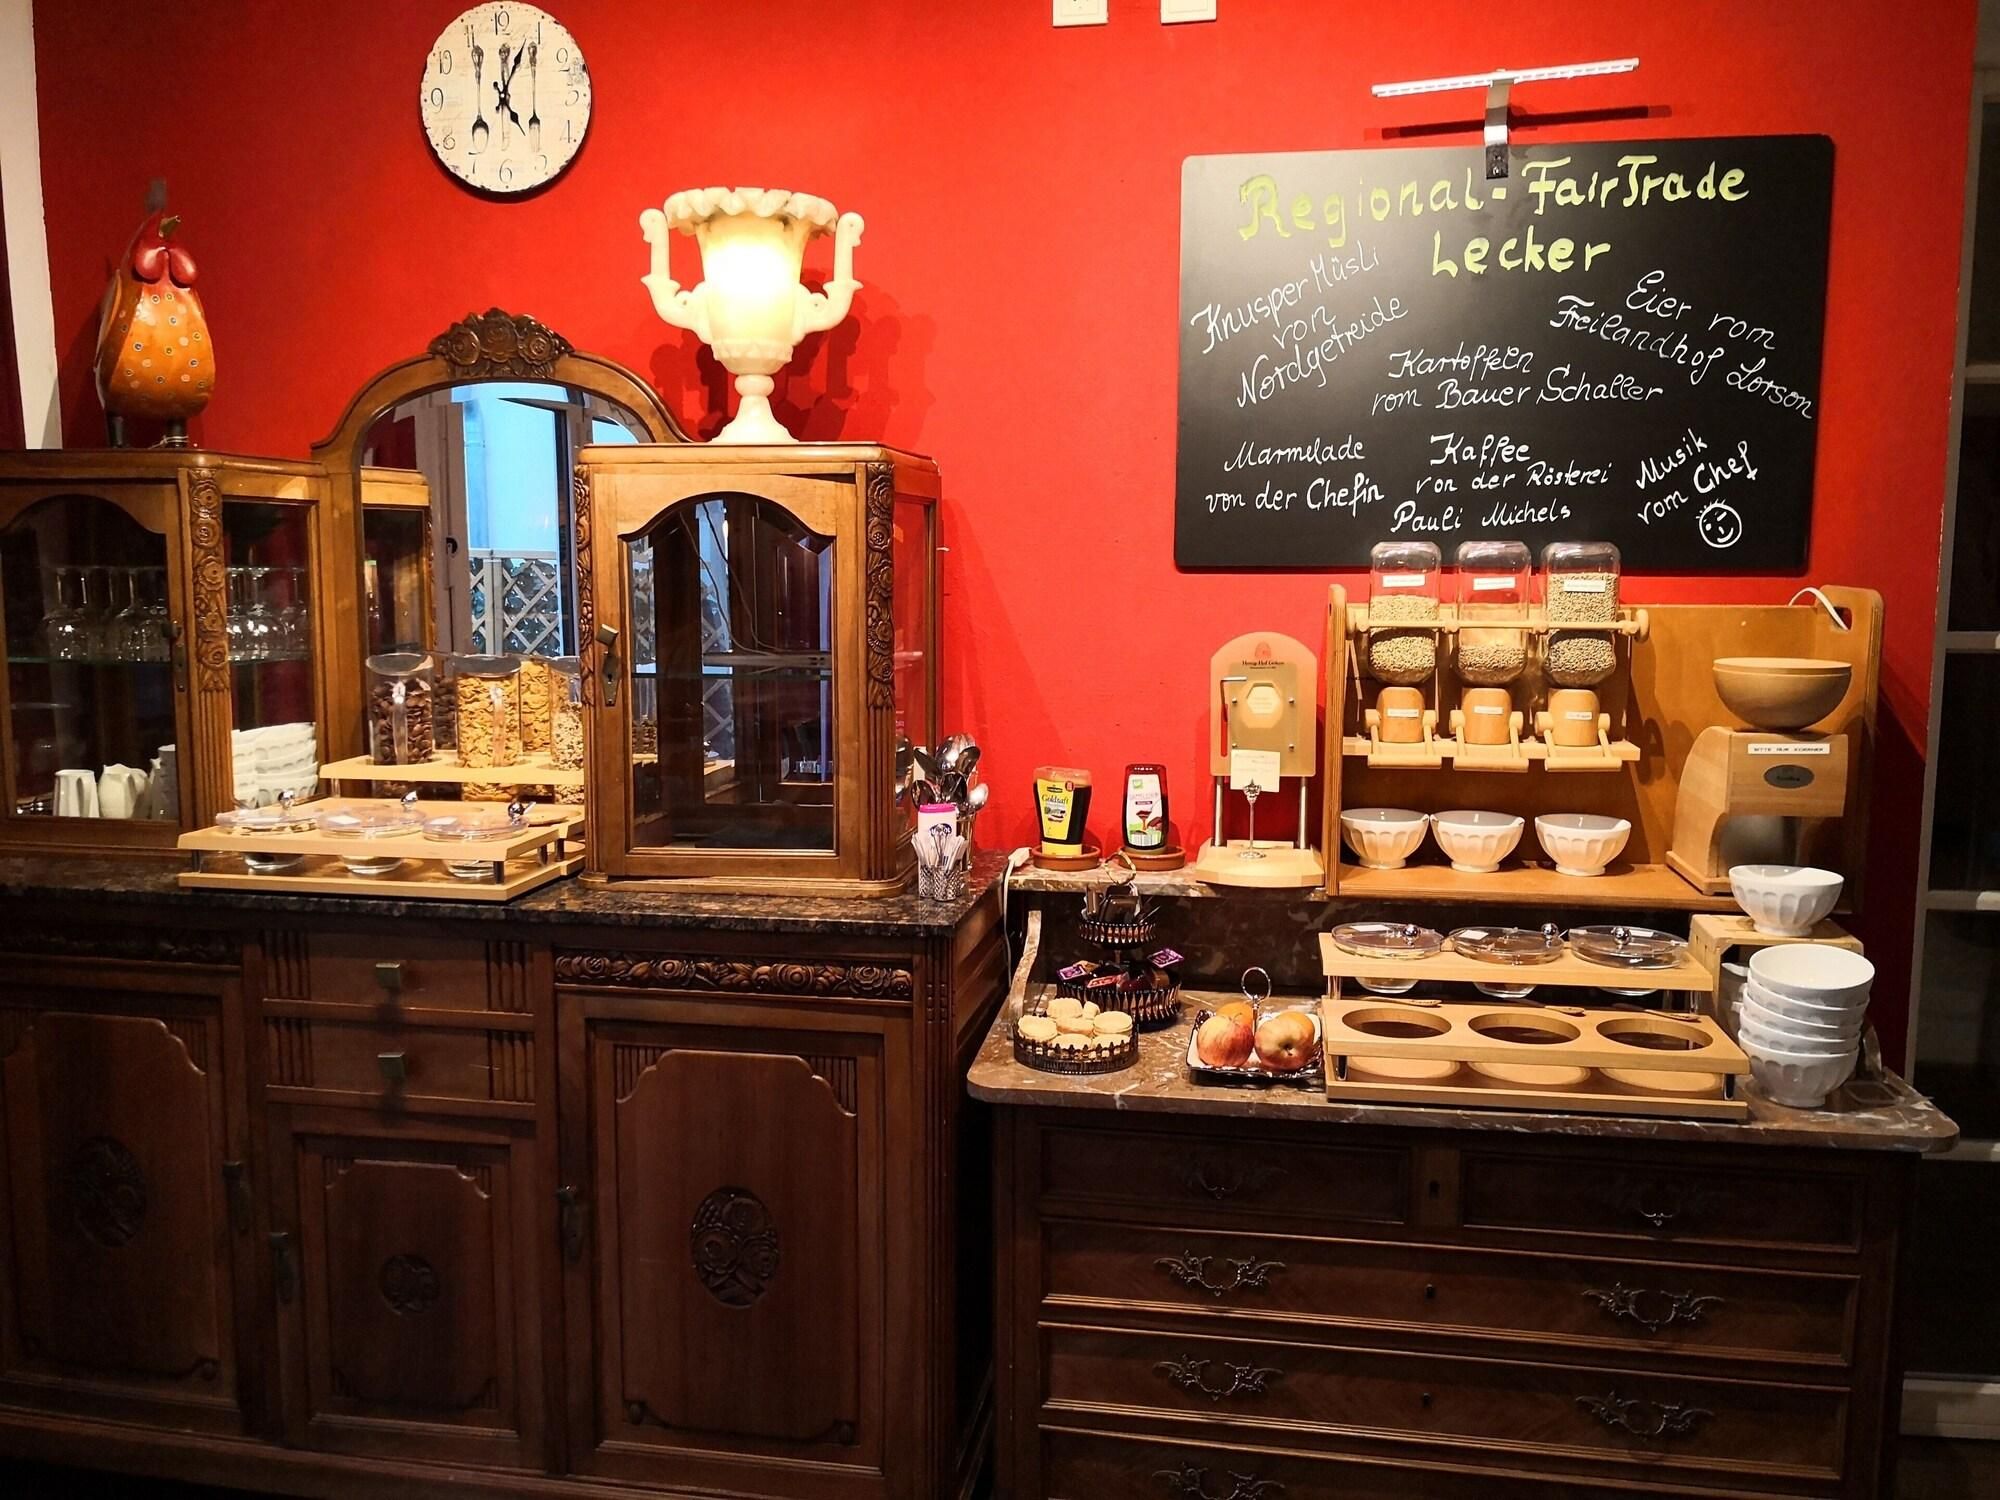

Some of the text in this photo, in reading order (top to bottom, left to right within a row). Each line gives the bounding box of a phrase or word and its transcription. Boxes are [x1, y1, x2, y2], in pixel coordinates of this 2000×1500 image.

[439, 49, 453, 75] 10
[430, 87, 444, 113] 9
[499, 158, 512, 183] 6
[1432, 225, 1611, 278] Lecker
[1190, 239, 1380, 354] Knusper Müsli
[1626, 270, 1692, 320] Eier
[1236, 296, 1409, 408] Nordgetreide
[1388, 341, 1534, 381] Kartoffeln
[1549, 295, 1725, 385] Freilandhof
[1435, 378, 1532, 409] Bauer
[1536, 364, 1664, 405] Schaller
[1223, 434, 1366, 472] Marmelade
[1430, 432, 1531, 468] Kaffee
[1635, 428, 1708, 490] Musik
[1693, 440, 1758, 494] Chef
[1205, 472, 1385, 518] von der Chefin
[1471, 472, 1516, 490] der
[1526, 459, 1613, 486] Rösterei
[1390, 498, 1571, 533] Pauli Michels
